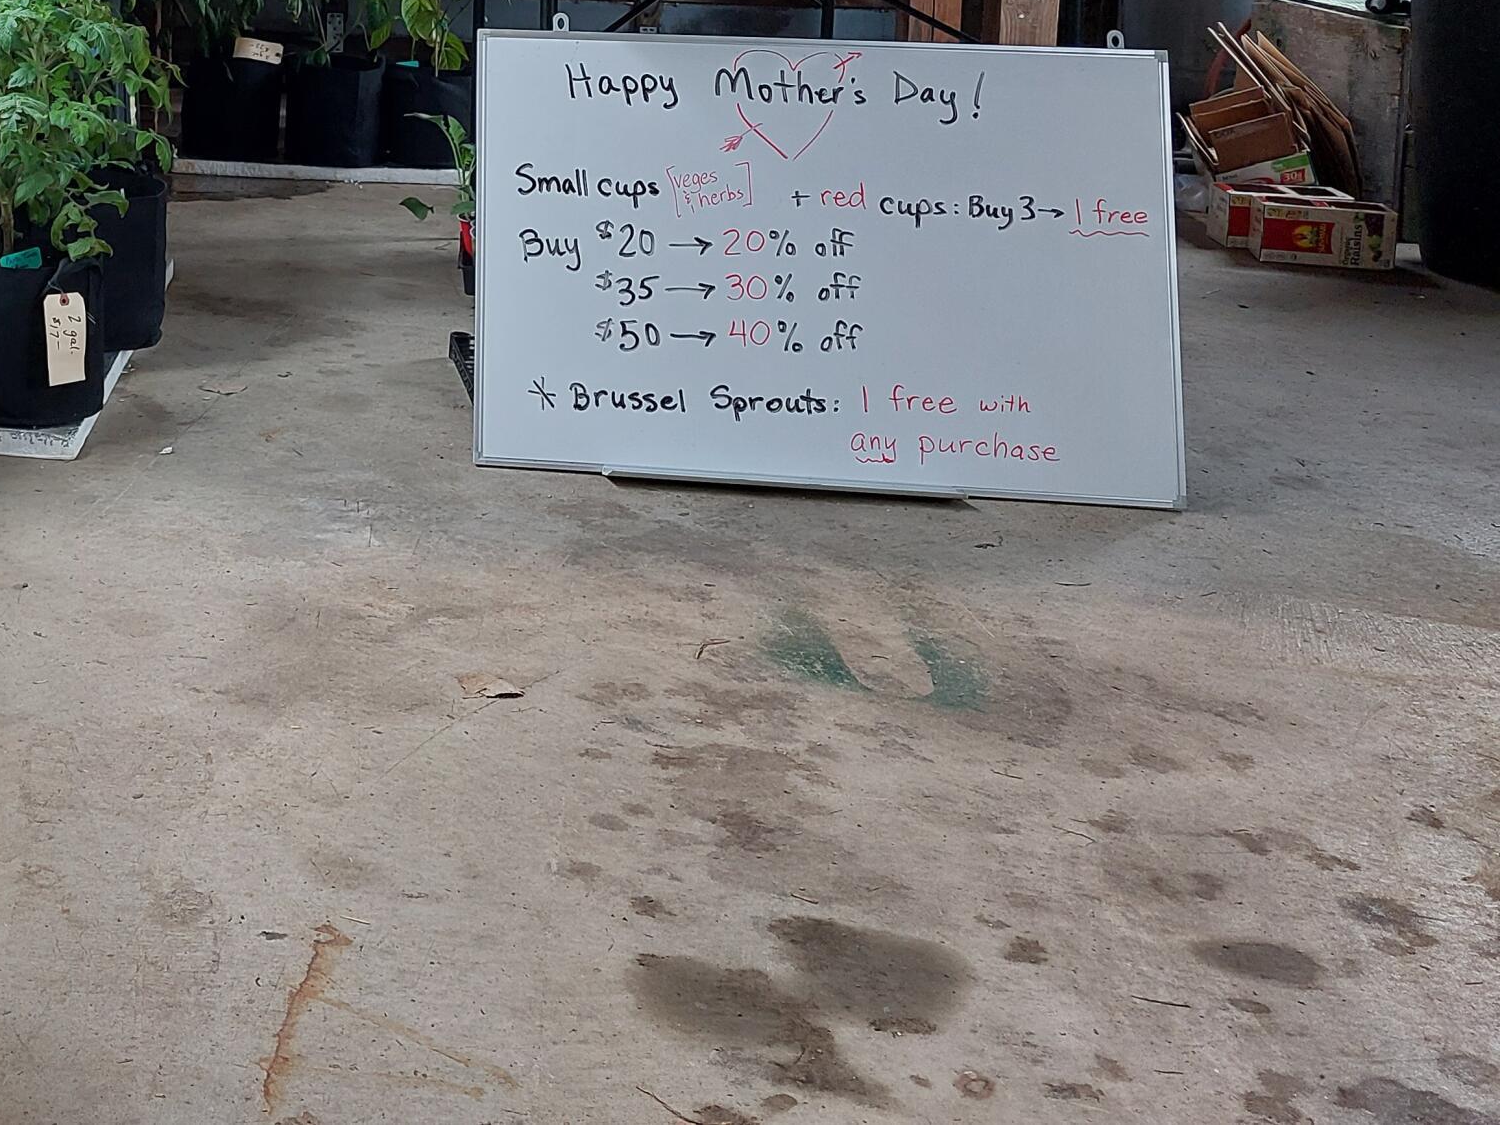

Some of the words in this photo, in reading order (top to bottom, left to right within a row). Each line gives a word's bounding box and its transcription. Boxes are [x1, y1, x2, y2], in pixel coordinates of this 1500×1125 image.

[565, 63, 678, 108] Happy
[715, 65, 866, 106] Mother's
[515, 163, 588, 196] Small
[597, 178, 660, 209] cups
[821, 184, 866, 209] red
[969, 195, 1013, 229] Buy
[1092, 199, 1148, 224] free
[519, 229, 581, 270] Buy
[723, 229, 796, 256] 20%
[815, 228, 854, 257] off
[1350, 221, 1362, 266] Raisins
[726, 273, 794, 302] 30%
[818, 272, 861, 301] off
[63, 330, 80, 355] gal.
[729, 319, 803, 352] 40%
[820, 321, 863, 352] off
[569, 383, 685, 413] Brussel
[710, 385, 839, 421] Sprouts:
[889, 390, 957, 413] free
[980, 395, 1031, 413] with
[851, 433, 896, 456] any
[919, 432, 1060, 465] purchase
